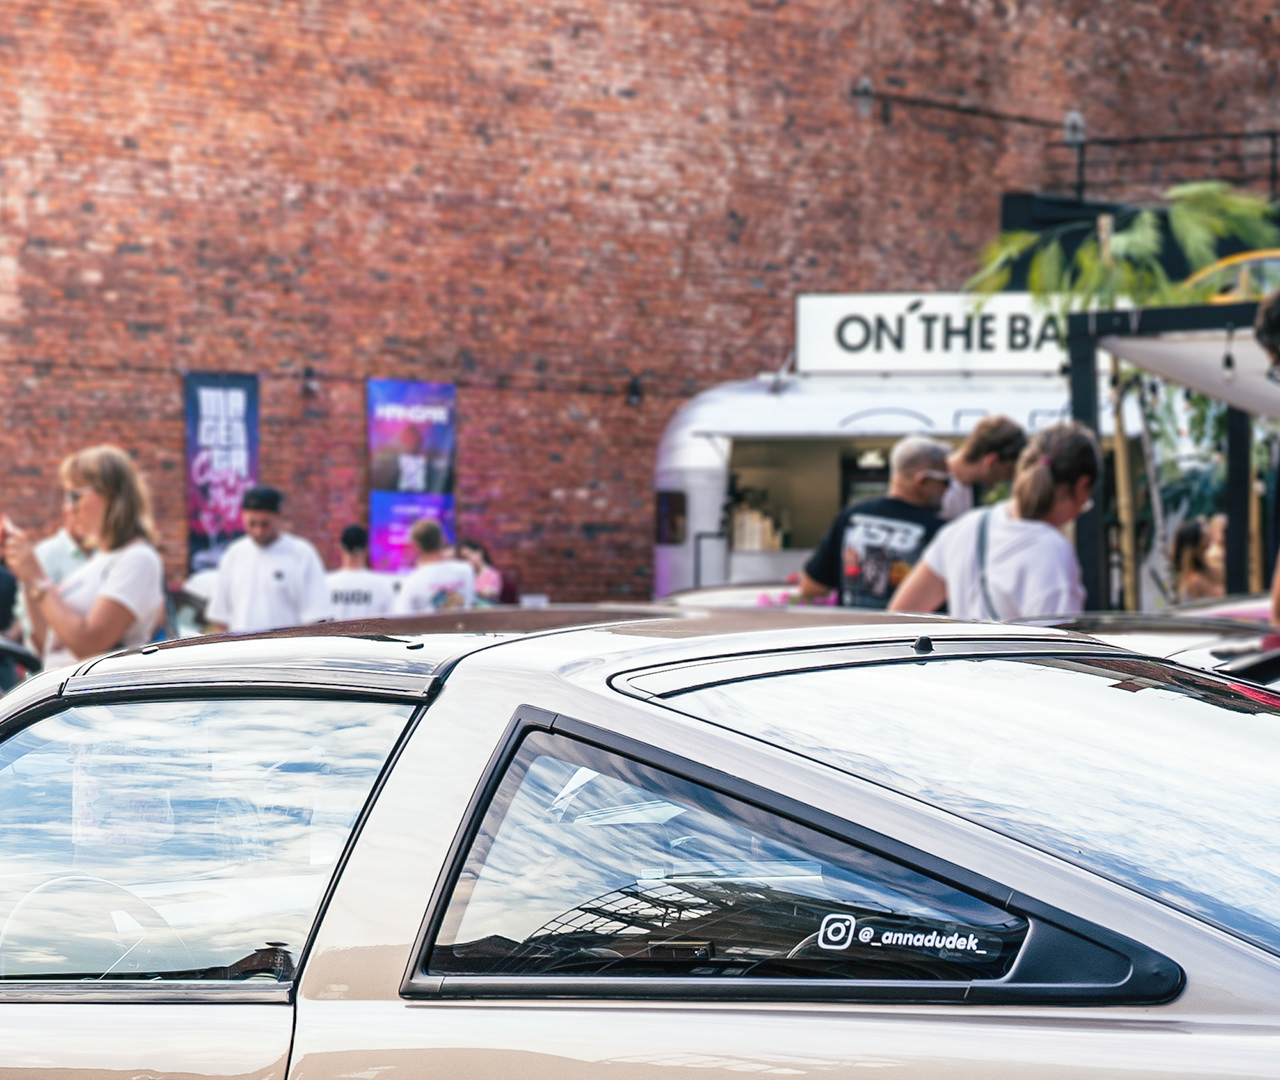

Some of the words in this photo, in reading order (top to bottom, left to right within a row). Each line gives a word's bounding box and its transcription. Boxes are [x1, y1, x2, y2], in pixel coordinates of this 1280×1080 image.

[835, 312, 905, 353] ON
[918, 313, 997, 352] THE
[1007, 312, 1063, 352] BA
[858, 927, 987, 955] @_annadudek_
